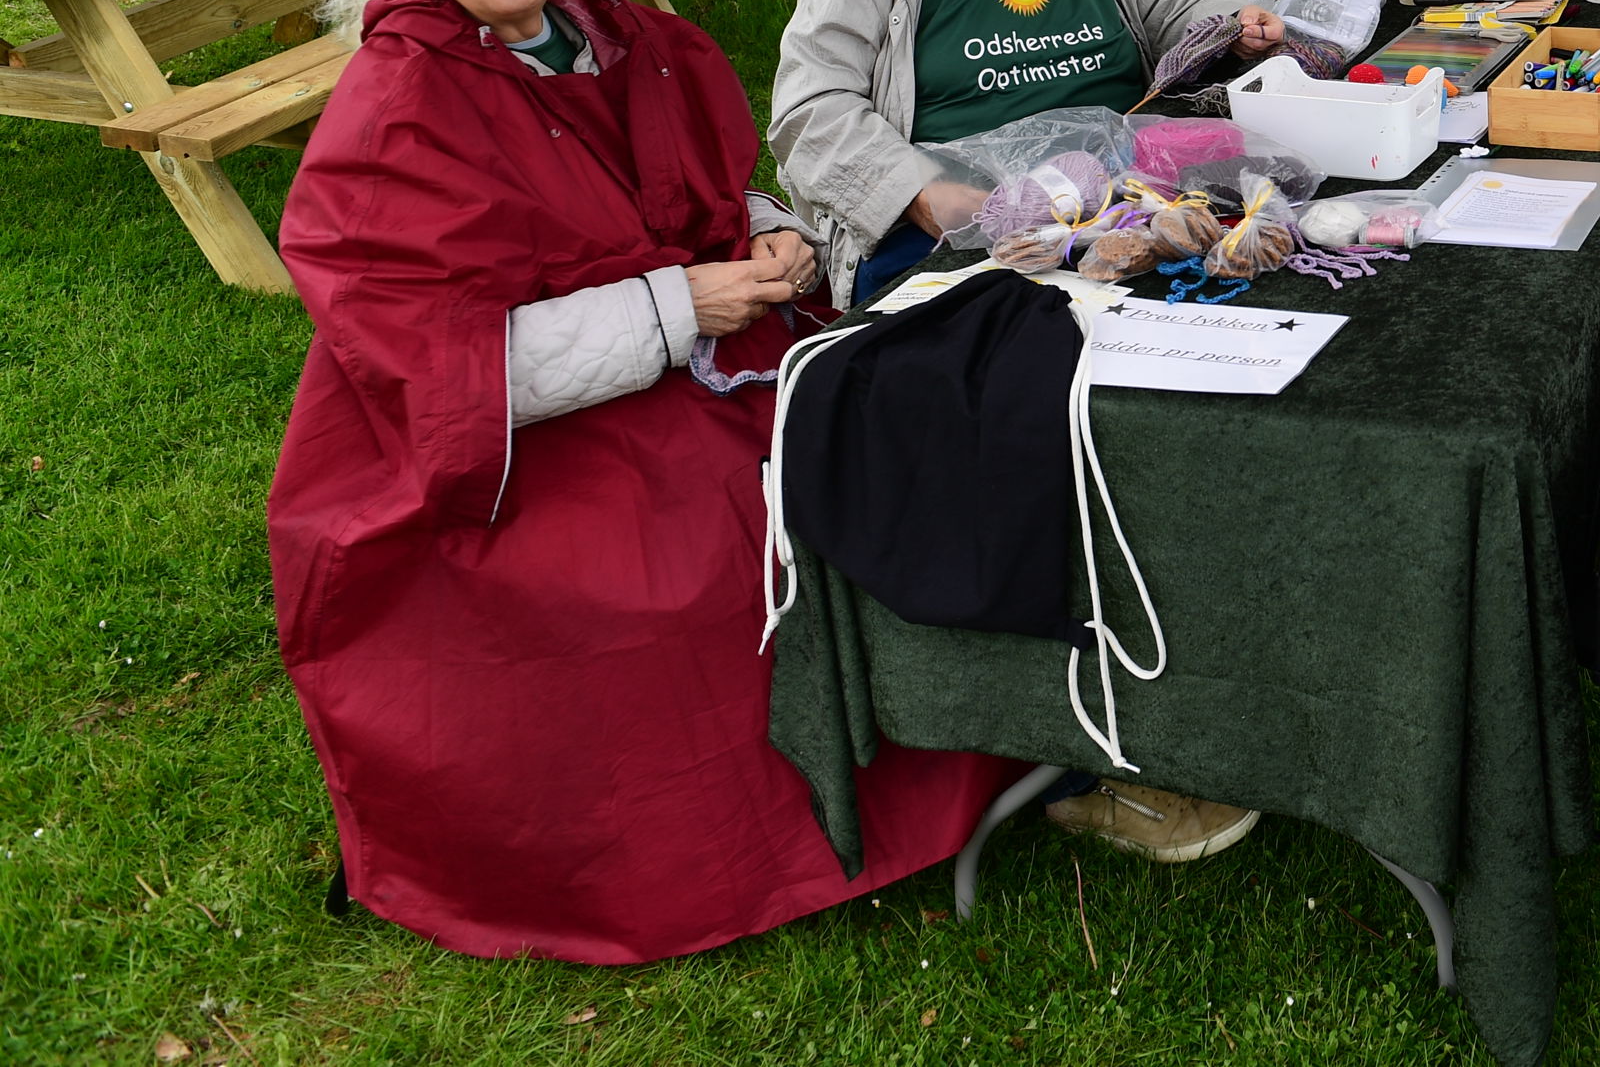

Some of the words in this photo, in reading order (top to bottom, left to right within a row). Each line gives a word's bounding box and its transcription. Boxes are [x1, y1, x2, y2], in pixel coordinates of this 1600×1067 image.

[963, 23, 1104, 60] Odsherreds
[977, 52, 1106, 91] Optimister
[1126, 309, 1184, 323] Prøv
[1189, 315, 1268, 330] lykken
[1091, 341, 1160, 353] odder
[1162, 348, 1195, 358] pr
[1198, 352, 1282, 367] person
